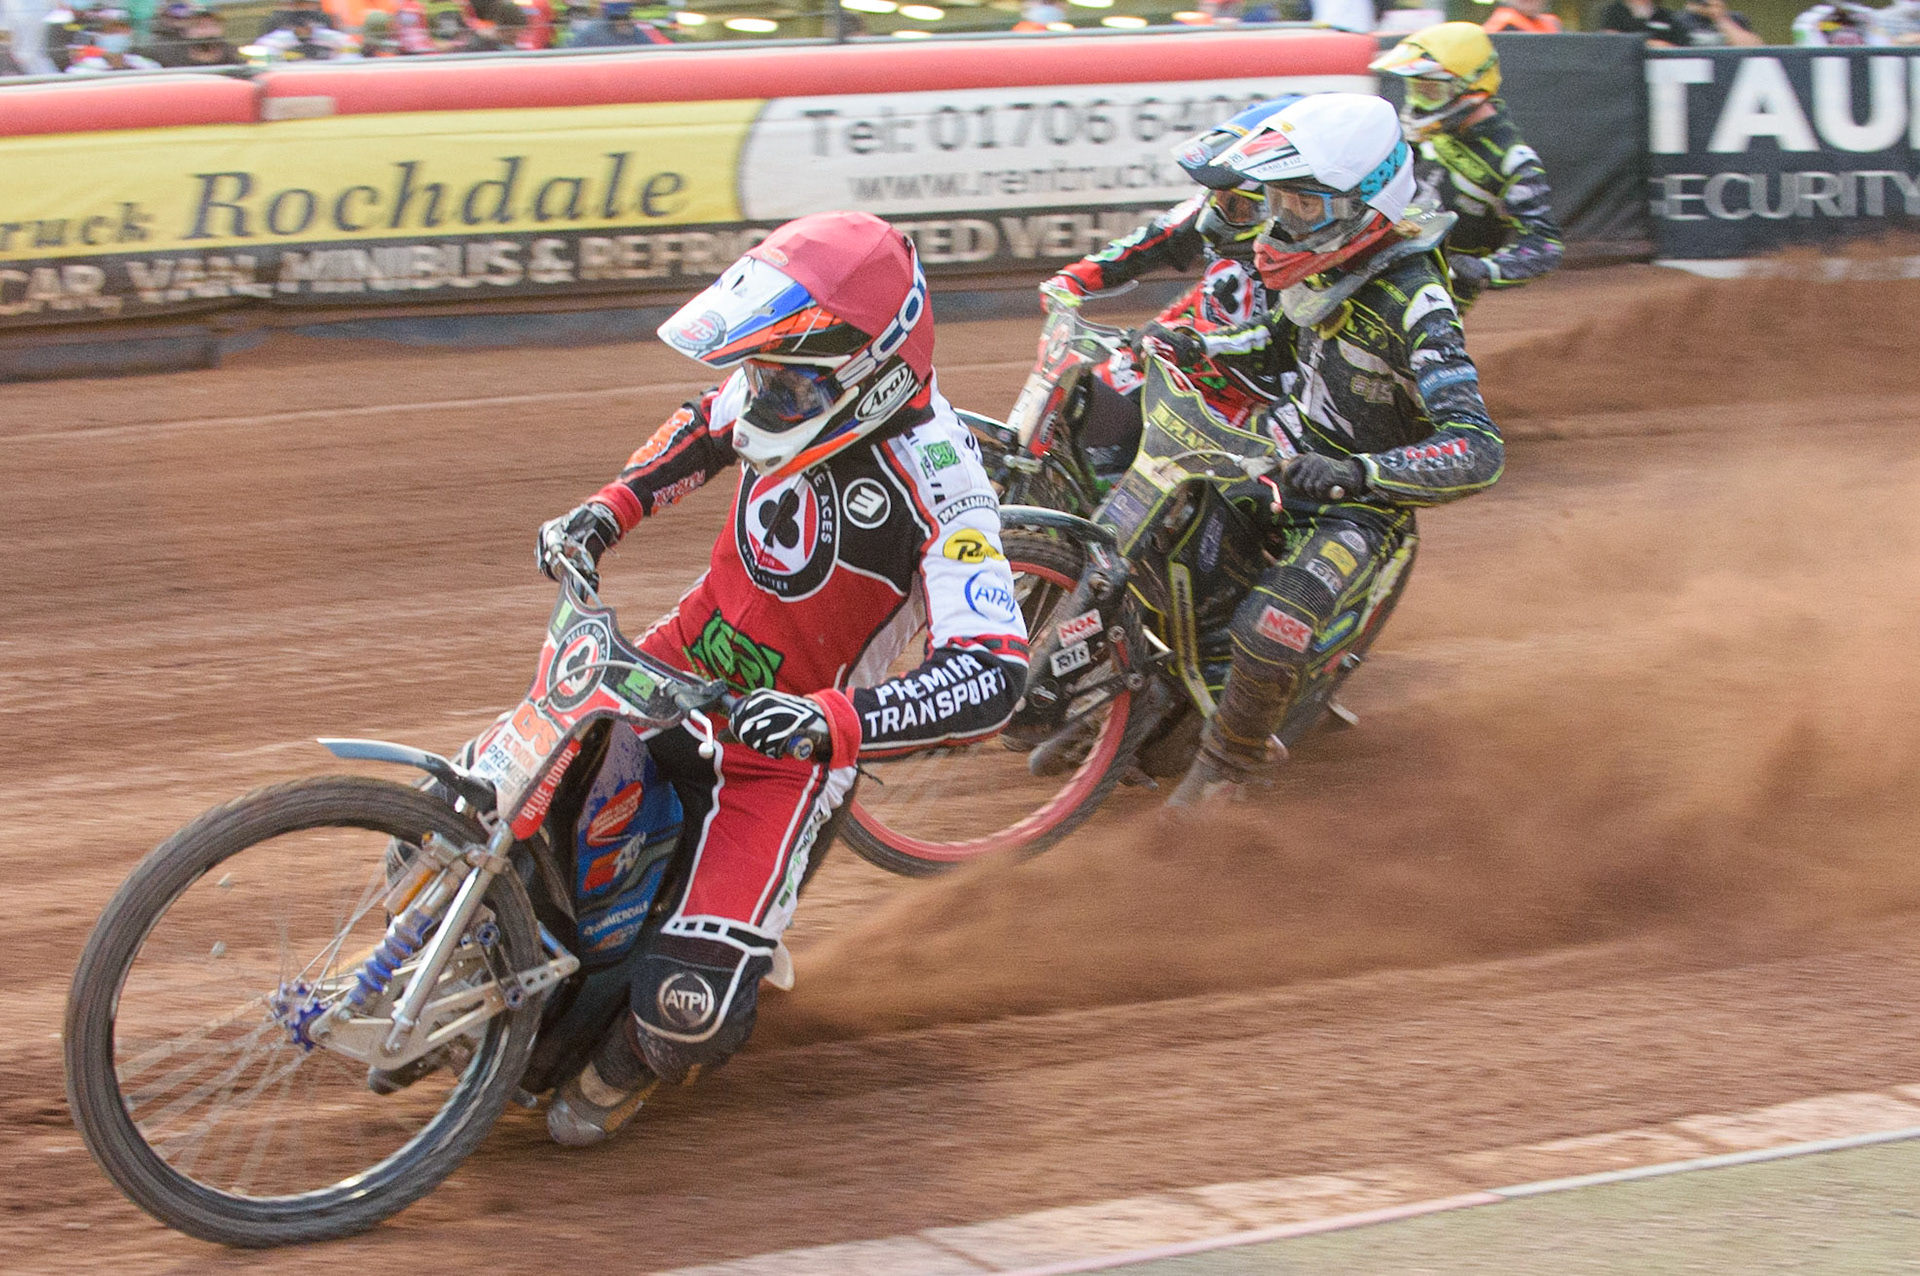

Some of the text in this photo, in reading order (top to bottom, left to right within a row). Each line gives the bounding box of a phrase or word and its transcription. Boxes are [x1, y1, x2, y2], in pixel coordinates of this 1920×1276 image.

[929, 98, 1118, 149] 01706
[1646, 55, 1920, 154] TAU
[182, 152, 687, 241] Rochdale
[277, 236, 522, 296] MINIBUS
[529, 235, 576, 284] &
[871, 371, 906, 410] Arai
[820, 494, 833, 545] ACES
[1060, 616, 1098, 639] NGK
[1265, 610, 1308, 643] NGK
[864, 666, 1007, 738] TRANSPORT
[521, 787, 551, 821] BLUE
[545, 748, 576, 788] DOOR
[665, 988, 707, 1012] ATPI
